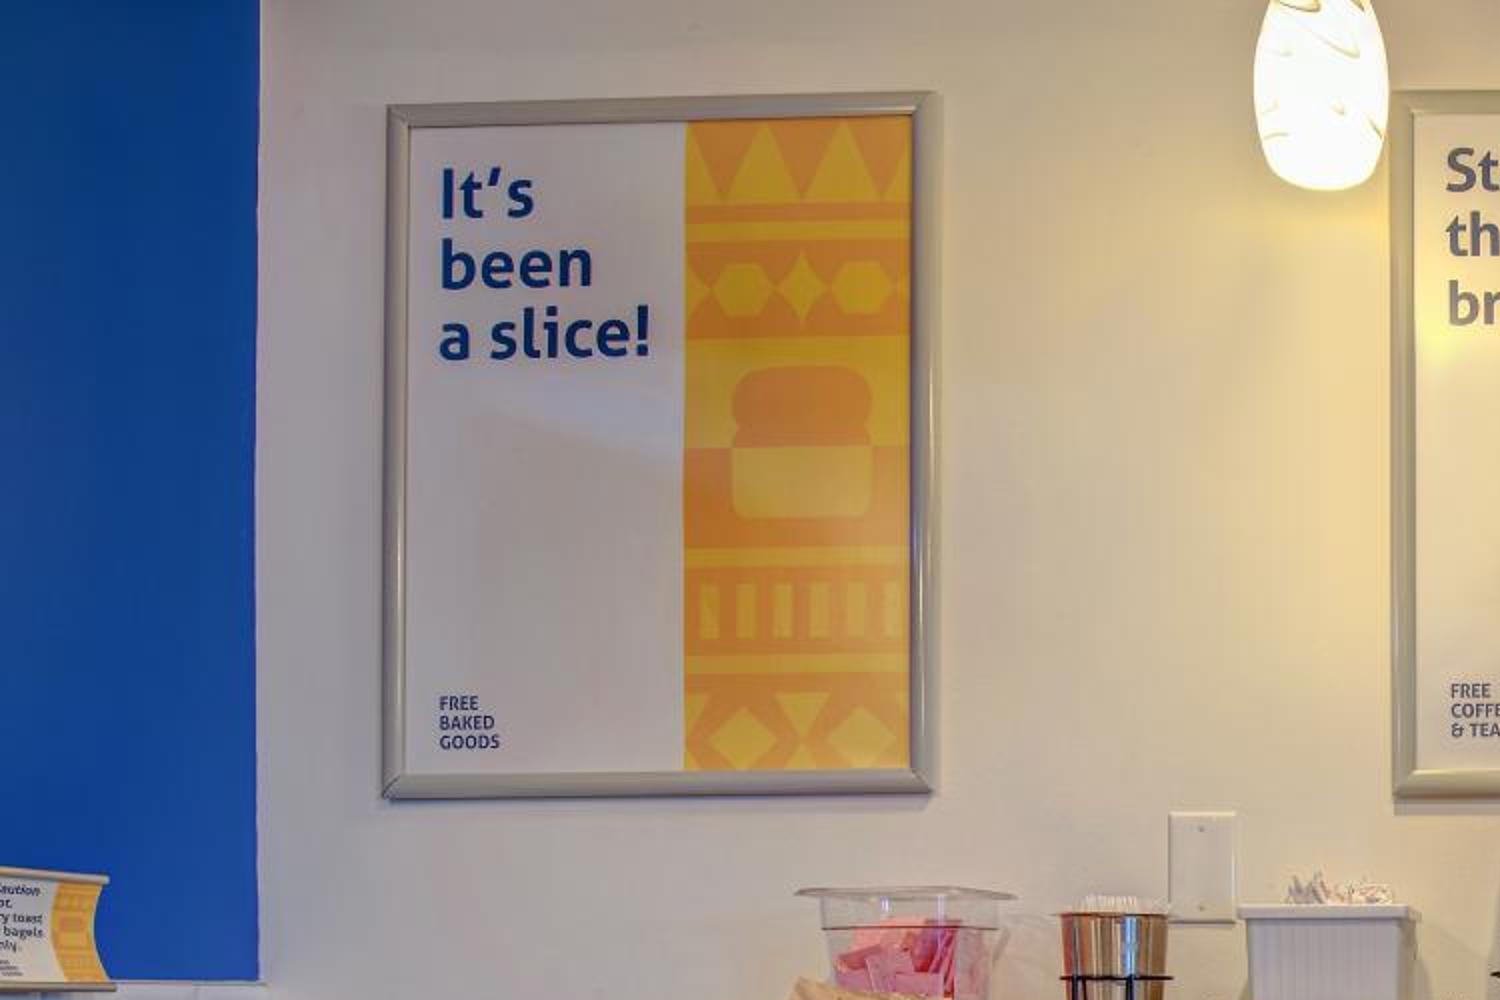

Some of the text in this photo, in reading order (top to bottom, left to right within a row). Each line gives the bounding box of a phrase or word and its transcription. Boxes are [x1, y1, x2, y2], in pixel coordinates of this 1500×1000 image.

[441, 166, 534, 219] It's
[441, 238, 592, 289] been
[439, 305, 649, 361] a slice!
[1451, 683, 1491, 698] FREE
[439, 695, 479, 711] FREE
[439, 715, 495, 730] BAKED
[1451, 722, 1500, 738] & TEA
[439, 734, 500, 750] GOODS
[3, 926, 43, 940] bagels
